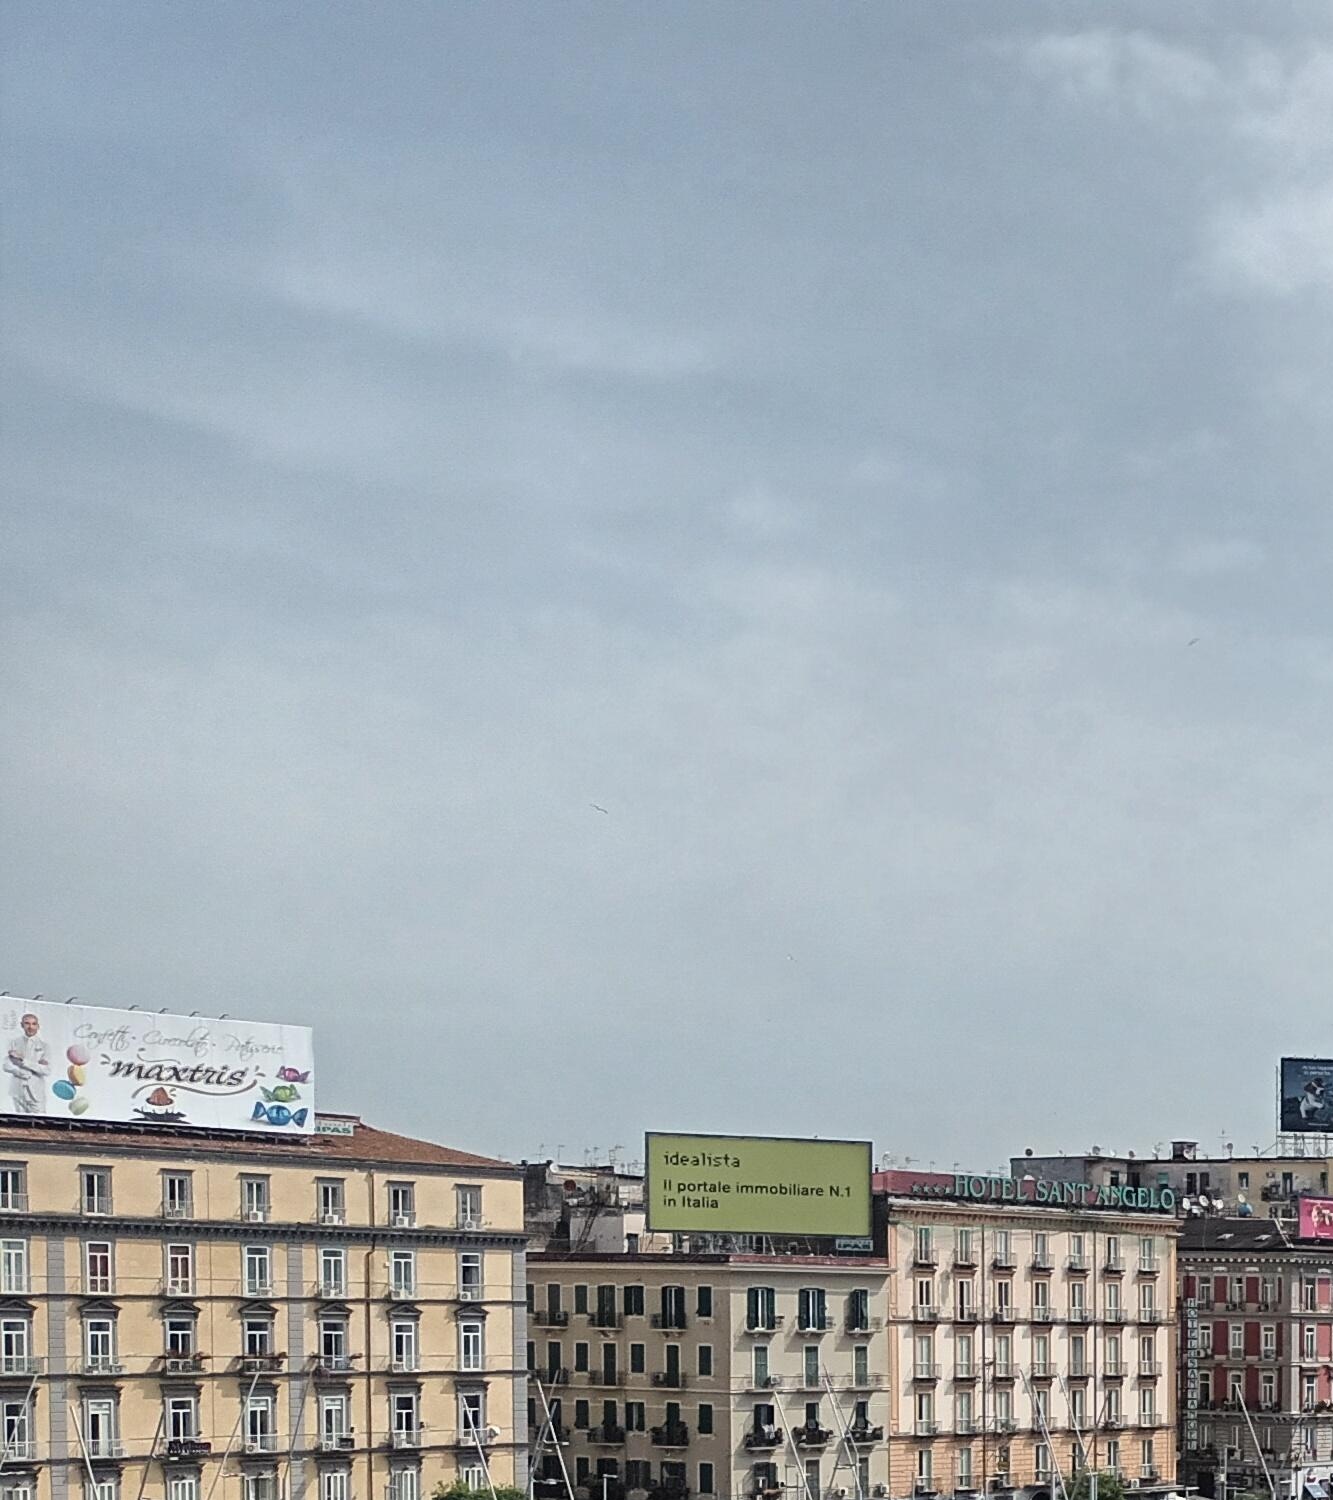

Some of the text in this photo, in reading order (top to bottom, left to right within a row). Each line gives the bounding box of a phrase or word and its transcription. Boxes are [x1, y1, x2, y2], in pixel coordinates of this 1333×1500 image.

[109, 1056, 249, 1087] maxtris
[663, 1151, 741, 1168] idealista
[663, 1179, 852, 1198] Il portale immobiliare N.1
[954, 1174, 1030, 1201] HOTEL
[663, 1195, 719, 1209] in Italia
